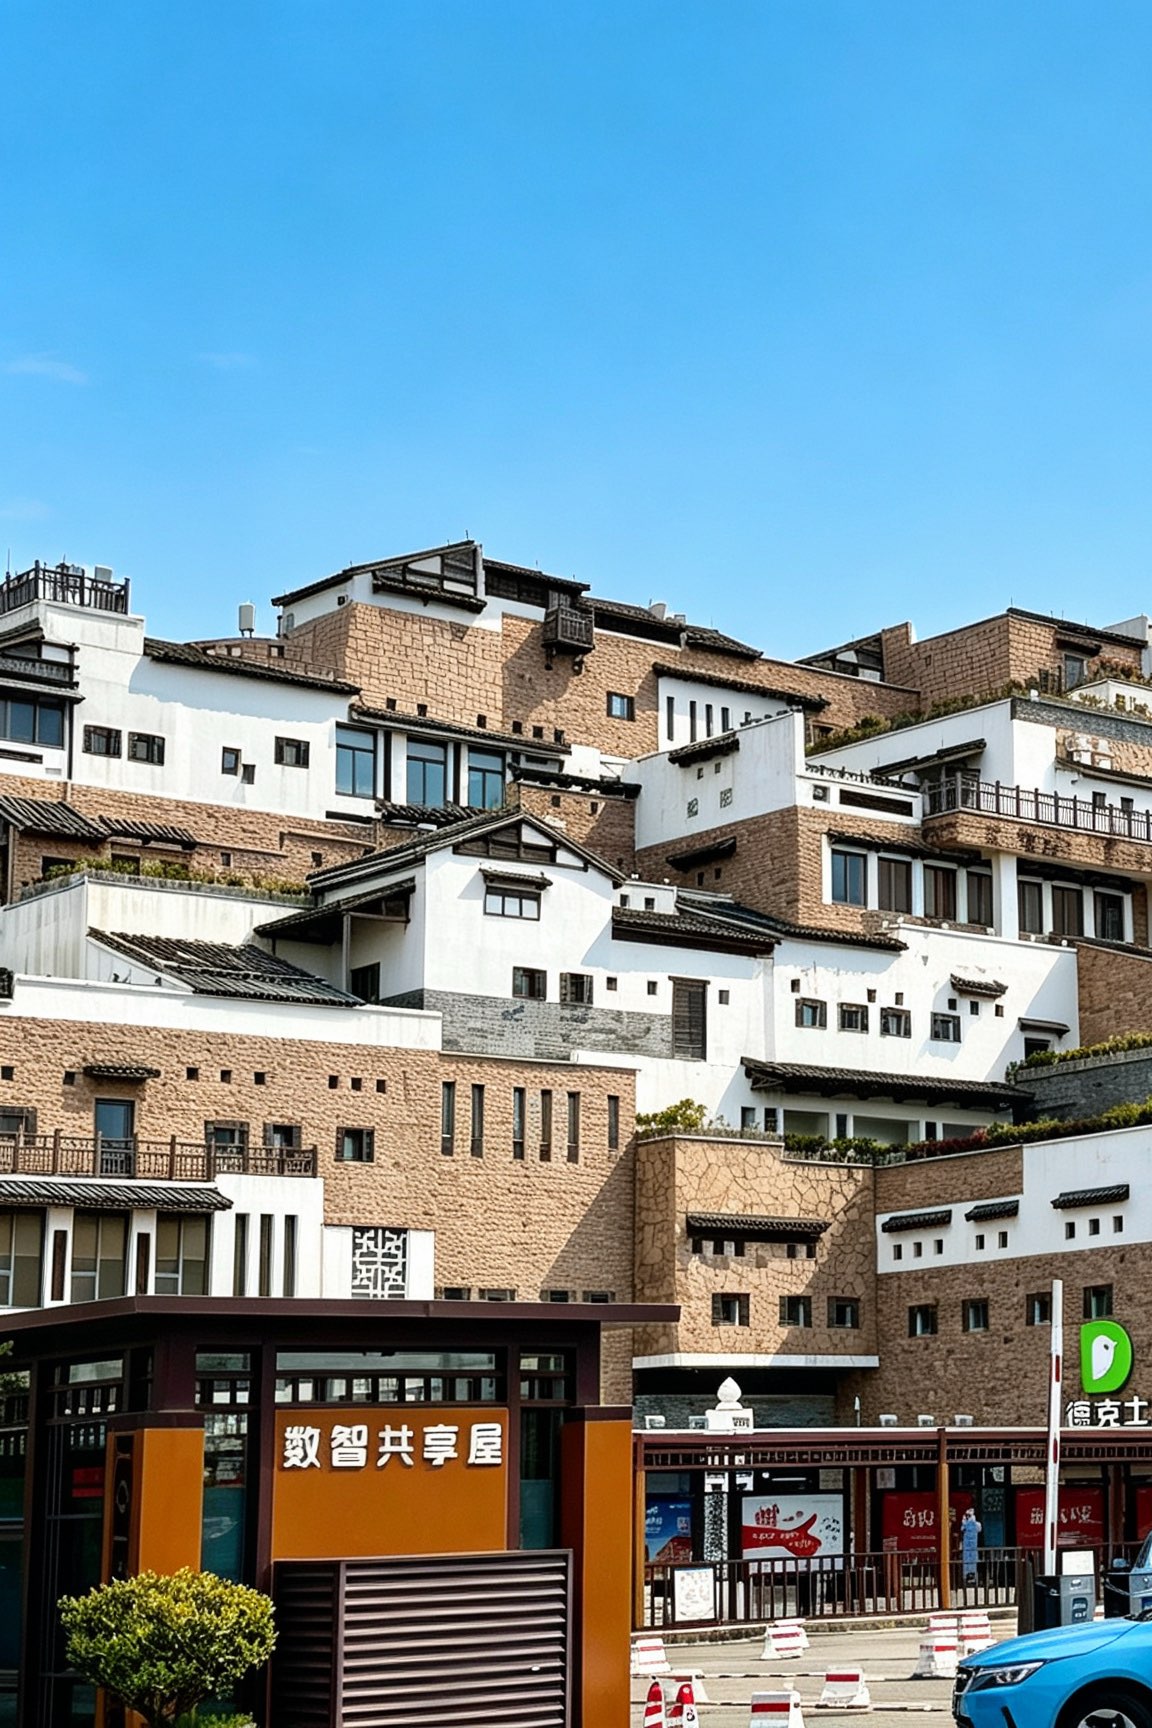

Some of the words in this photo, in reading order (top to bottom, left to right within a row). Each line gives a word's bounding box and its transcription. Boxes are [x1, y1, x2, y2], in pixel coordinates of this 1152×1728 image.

[283, 1423, 502, 1468] 数智共享屋
